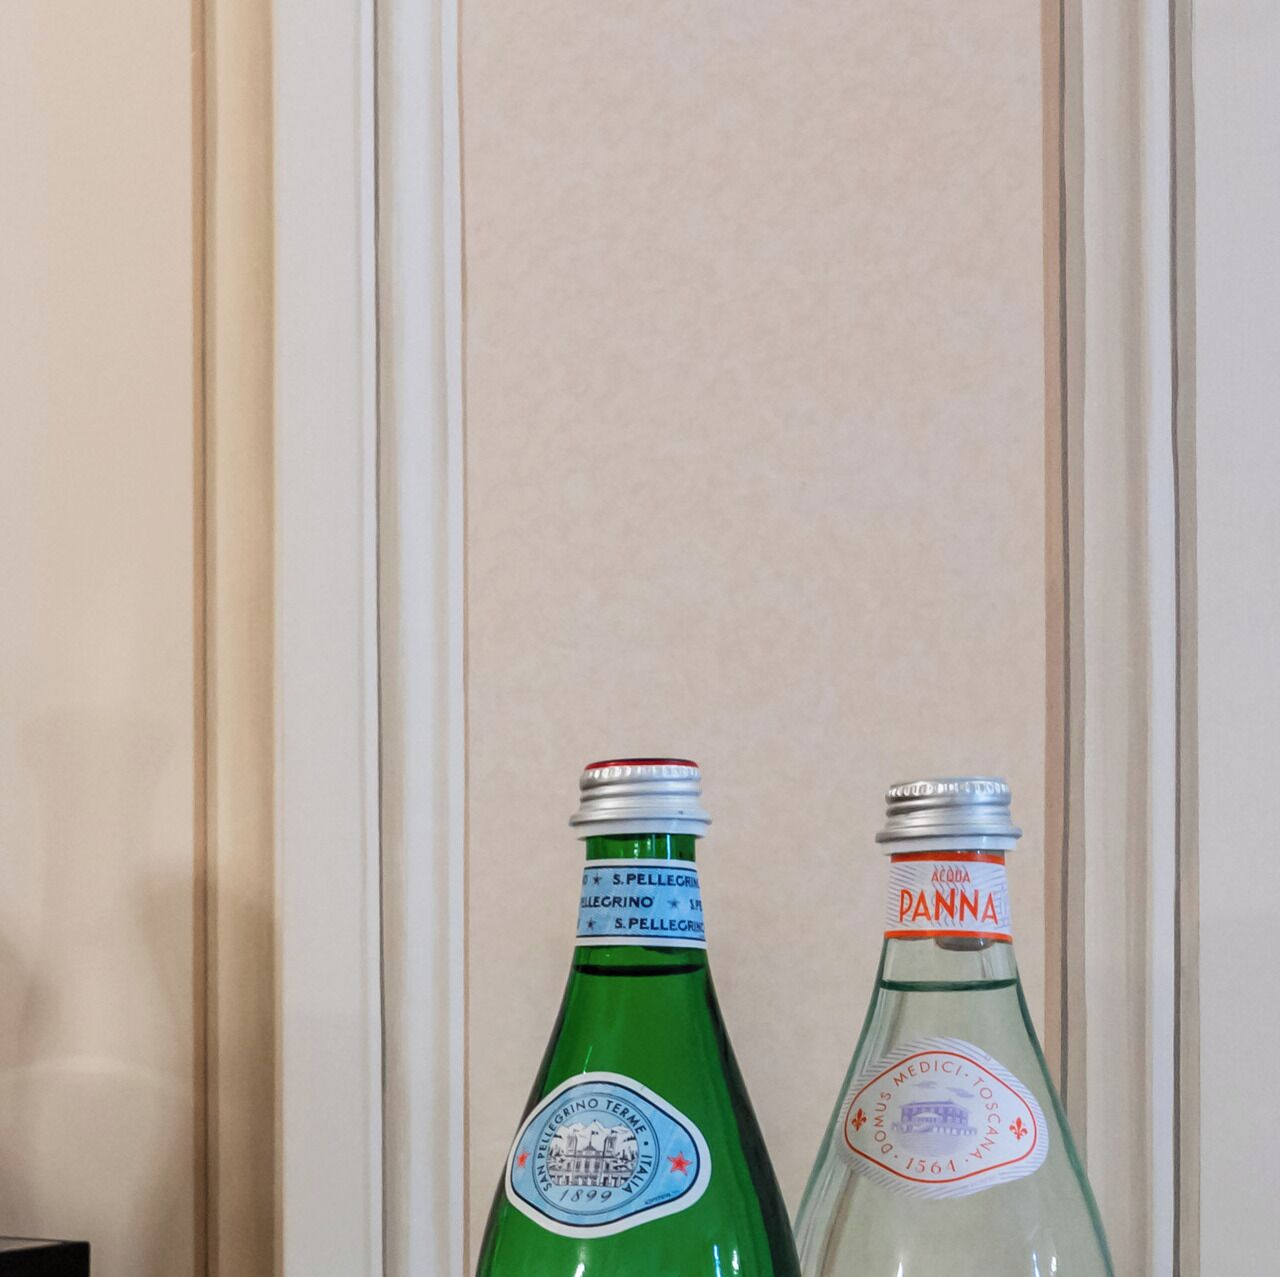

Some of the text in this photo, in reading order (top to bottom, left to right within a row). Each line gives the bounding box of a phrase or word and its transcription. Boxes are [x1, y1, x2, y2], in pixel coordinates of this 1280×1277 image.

[931, 868, 971, 883] ACQUA
[899, 887, 999, 926] PANNA
[873, 1060, 1002, 1160] DOMUS MEDICI TOSCANA
[536, 1098, 653, 1194] SAN PELLEGRINO TERME ITALIA
[559, 1188, 613, 1203] 1899
